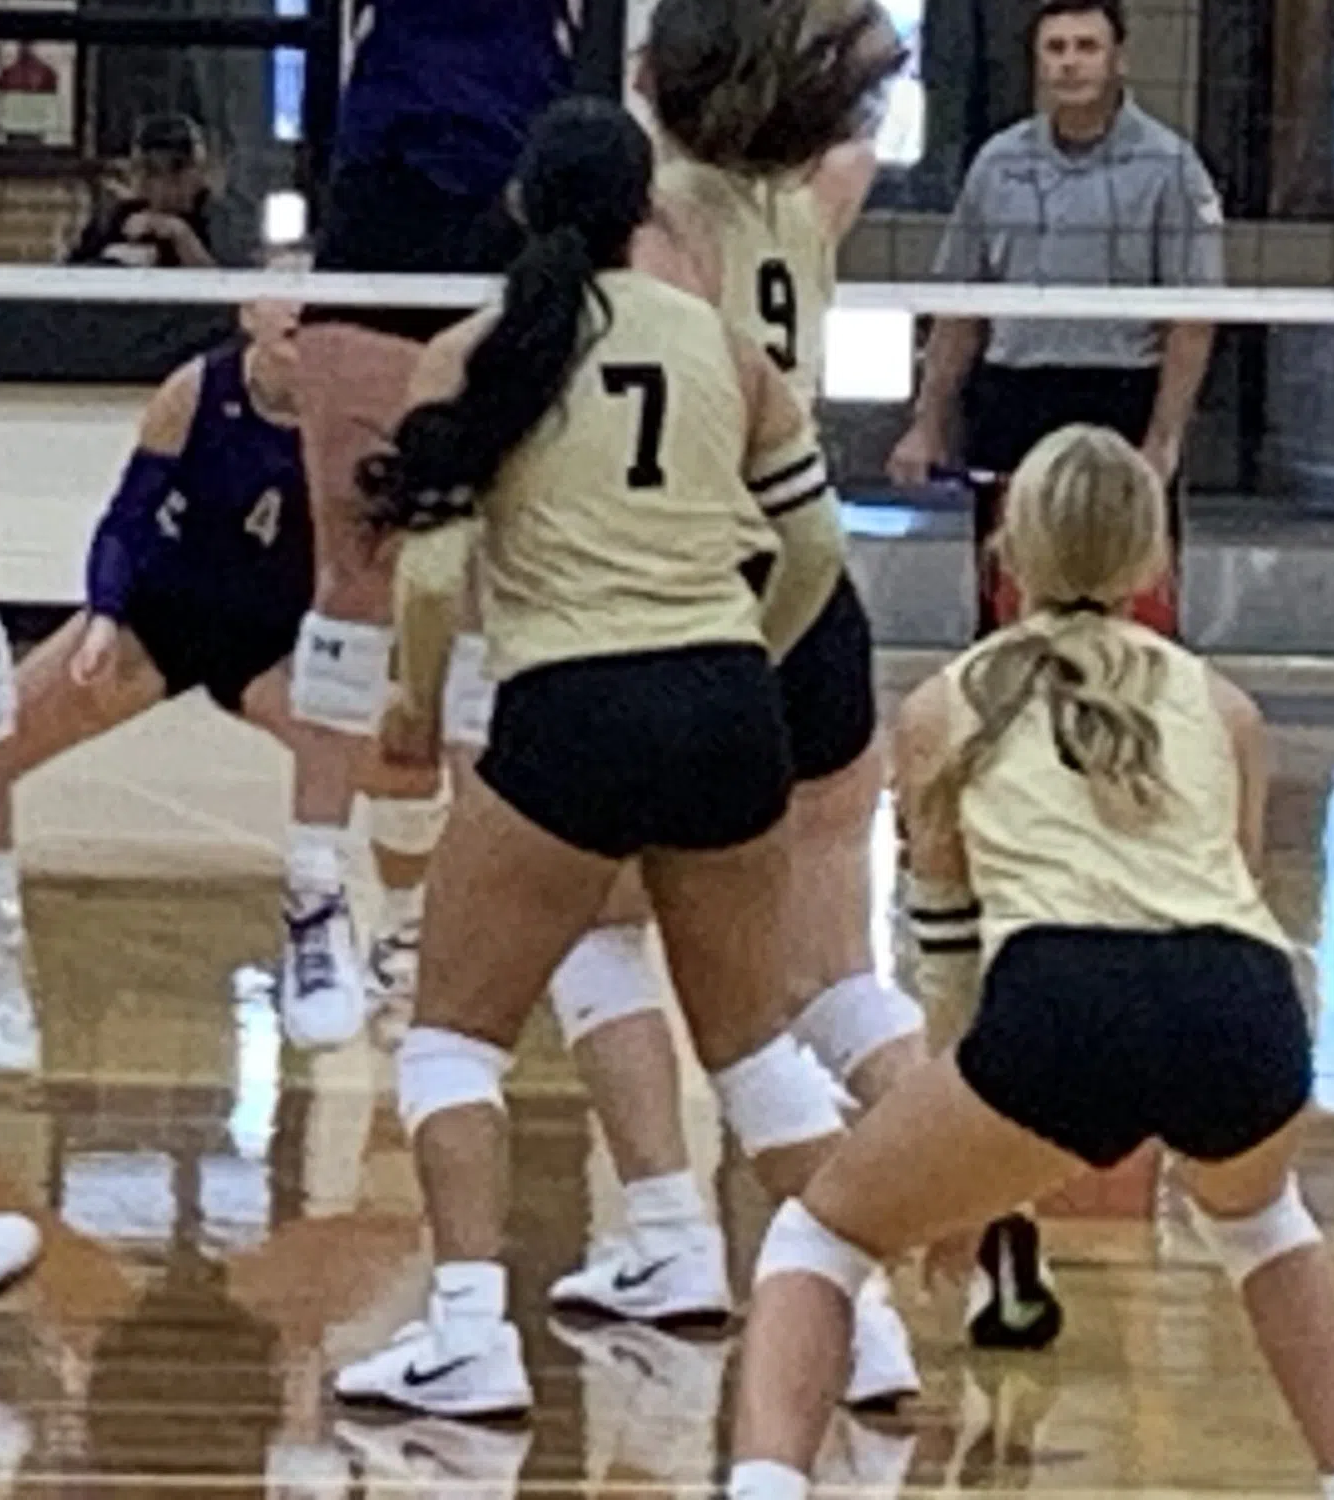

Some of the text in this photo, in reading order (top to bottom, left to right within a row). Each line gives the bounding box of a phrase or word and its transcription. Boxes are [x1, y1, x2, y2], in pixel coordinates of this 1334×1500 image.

[757, 258, 796, 372] 9
[599, 362, 666, 488] 7
[244, 486, 282, 548] 4
